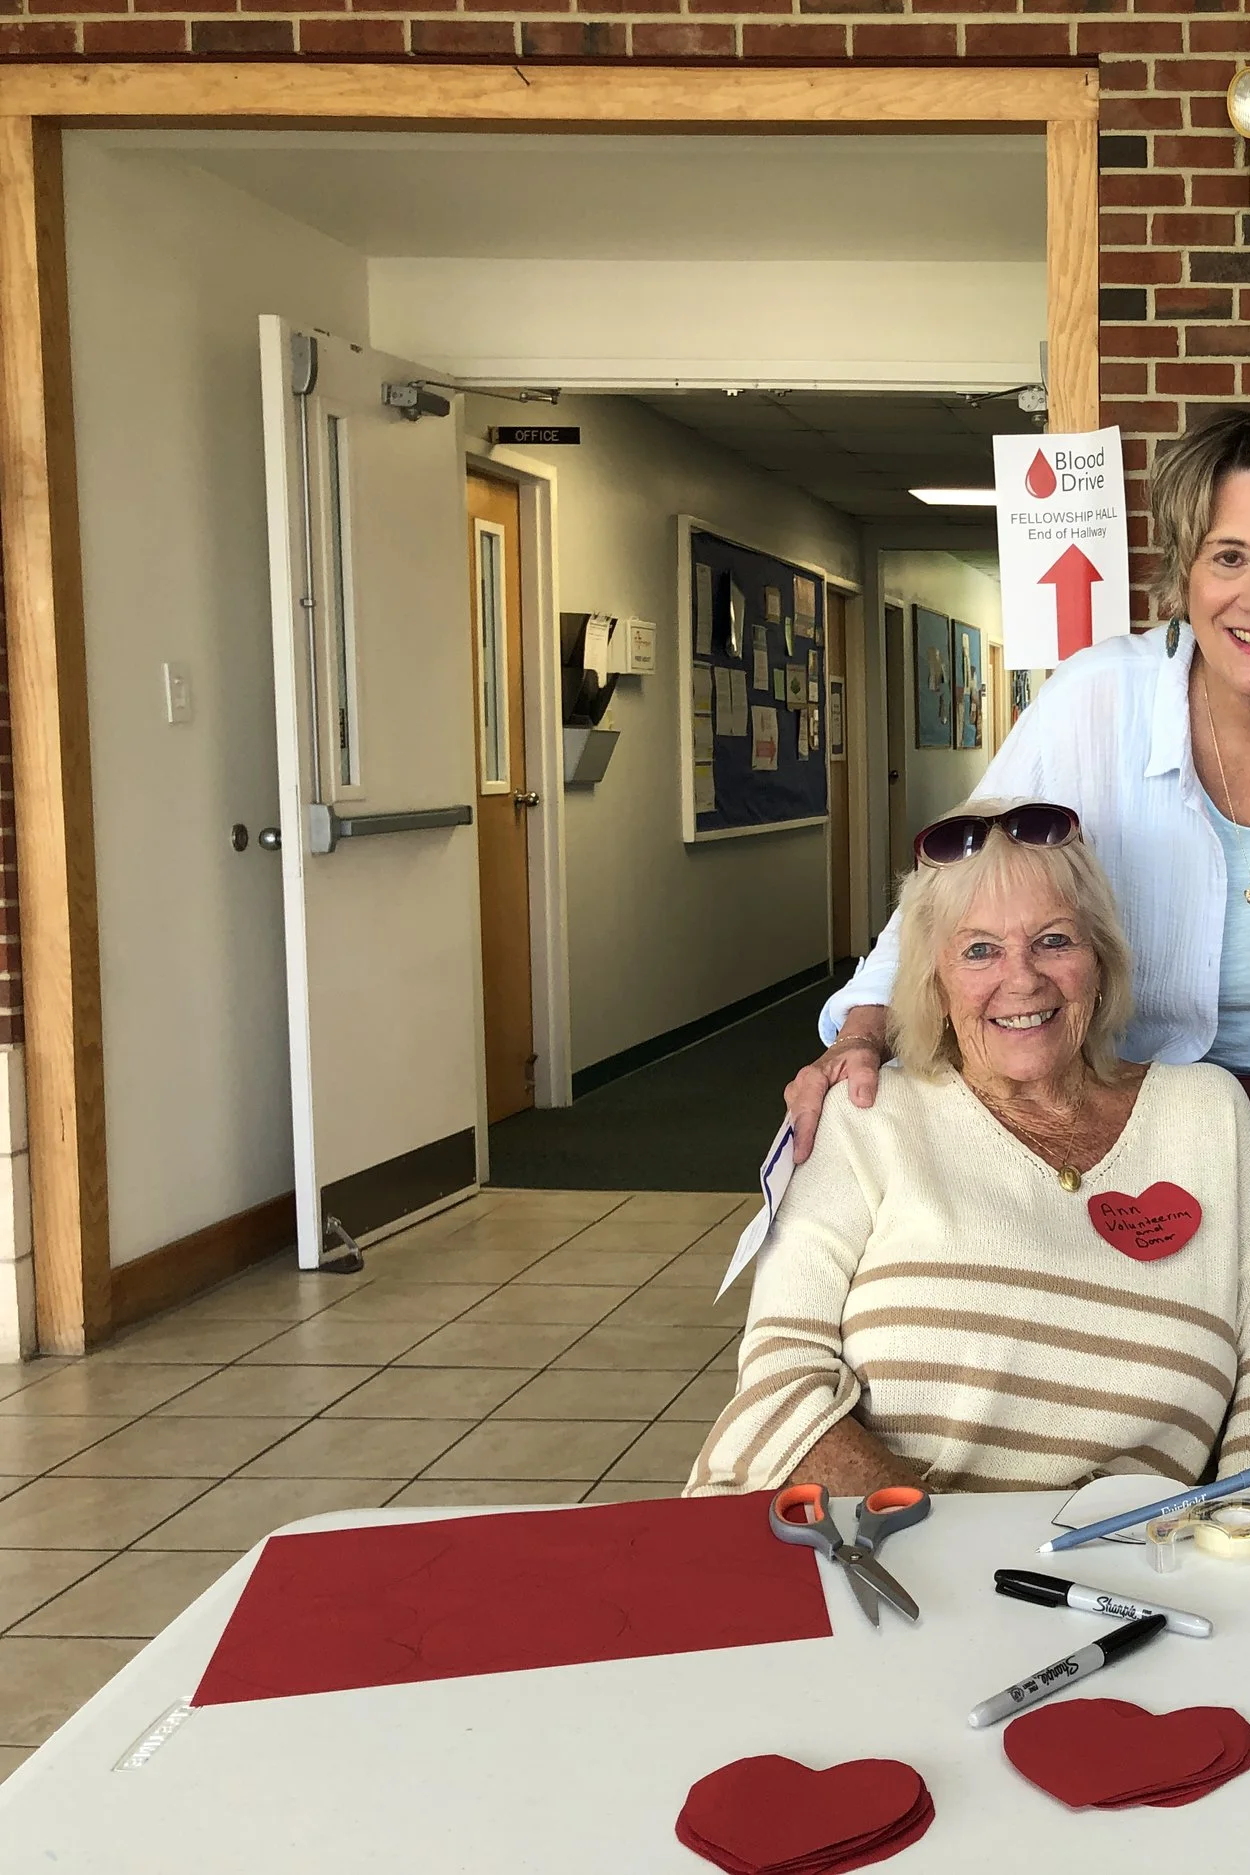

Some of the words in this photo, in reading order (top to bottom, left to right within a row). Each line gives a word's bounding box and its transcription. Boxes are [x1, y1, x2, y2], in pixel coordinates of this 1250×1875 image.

[515, 430, 560, 441] OFFICE
[1055, 446, 1105, 470] Blood
[1062, 472, 1105, 492] Drive
[1010, 510, 1093, 525] FELLOWSHIP
[1095, 507, 1118, 520] HALL
[1028, 528, 1052, 540] End
[1055, 527, 1068, 539] of
[1070, 526, 1107, 539] Hallway
[1100, 1202, 1142, 1217] Ann
[1135, 1224, 1164, 1236] and
[1134, 1233, 1176, 1249] Donor
[1092, 1596, 1138, 1620] Sharpie
[1041, 1655, 1079, 1686] Sharpie
